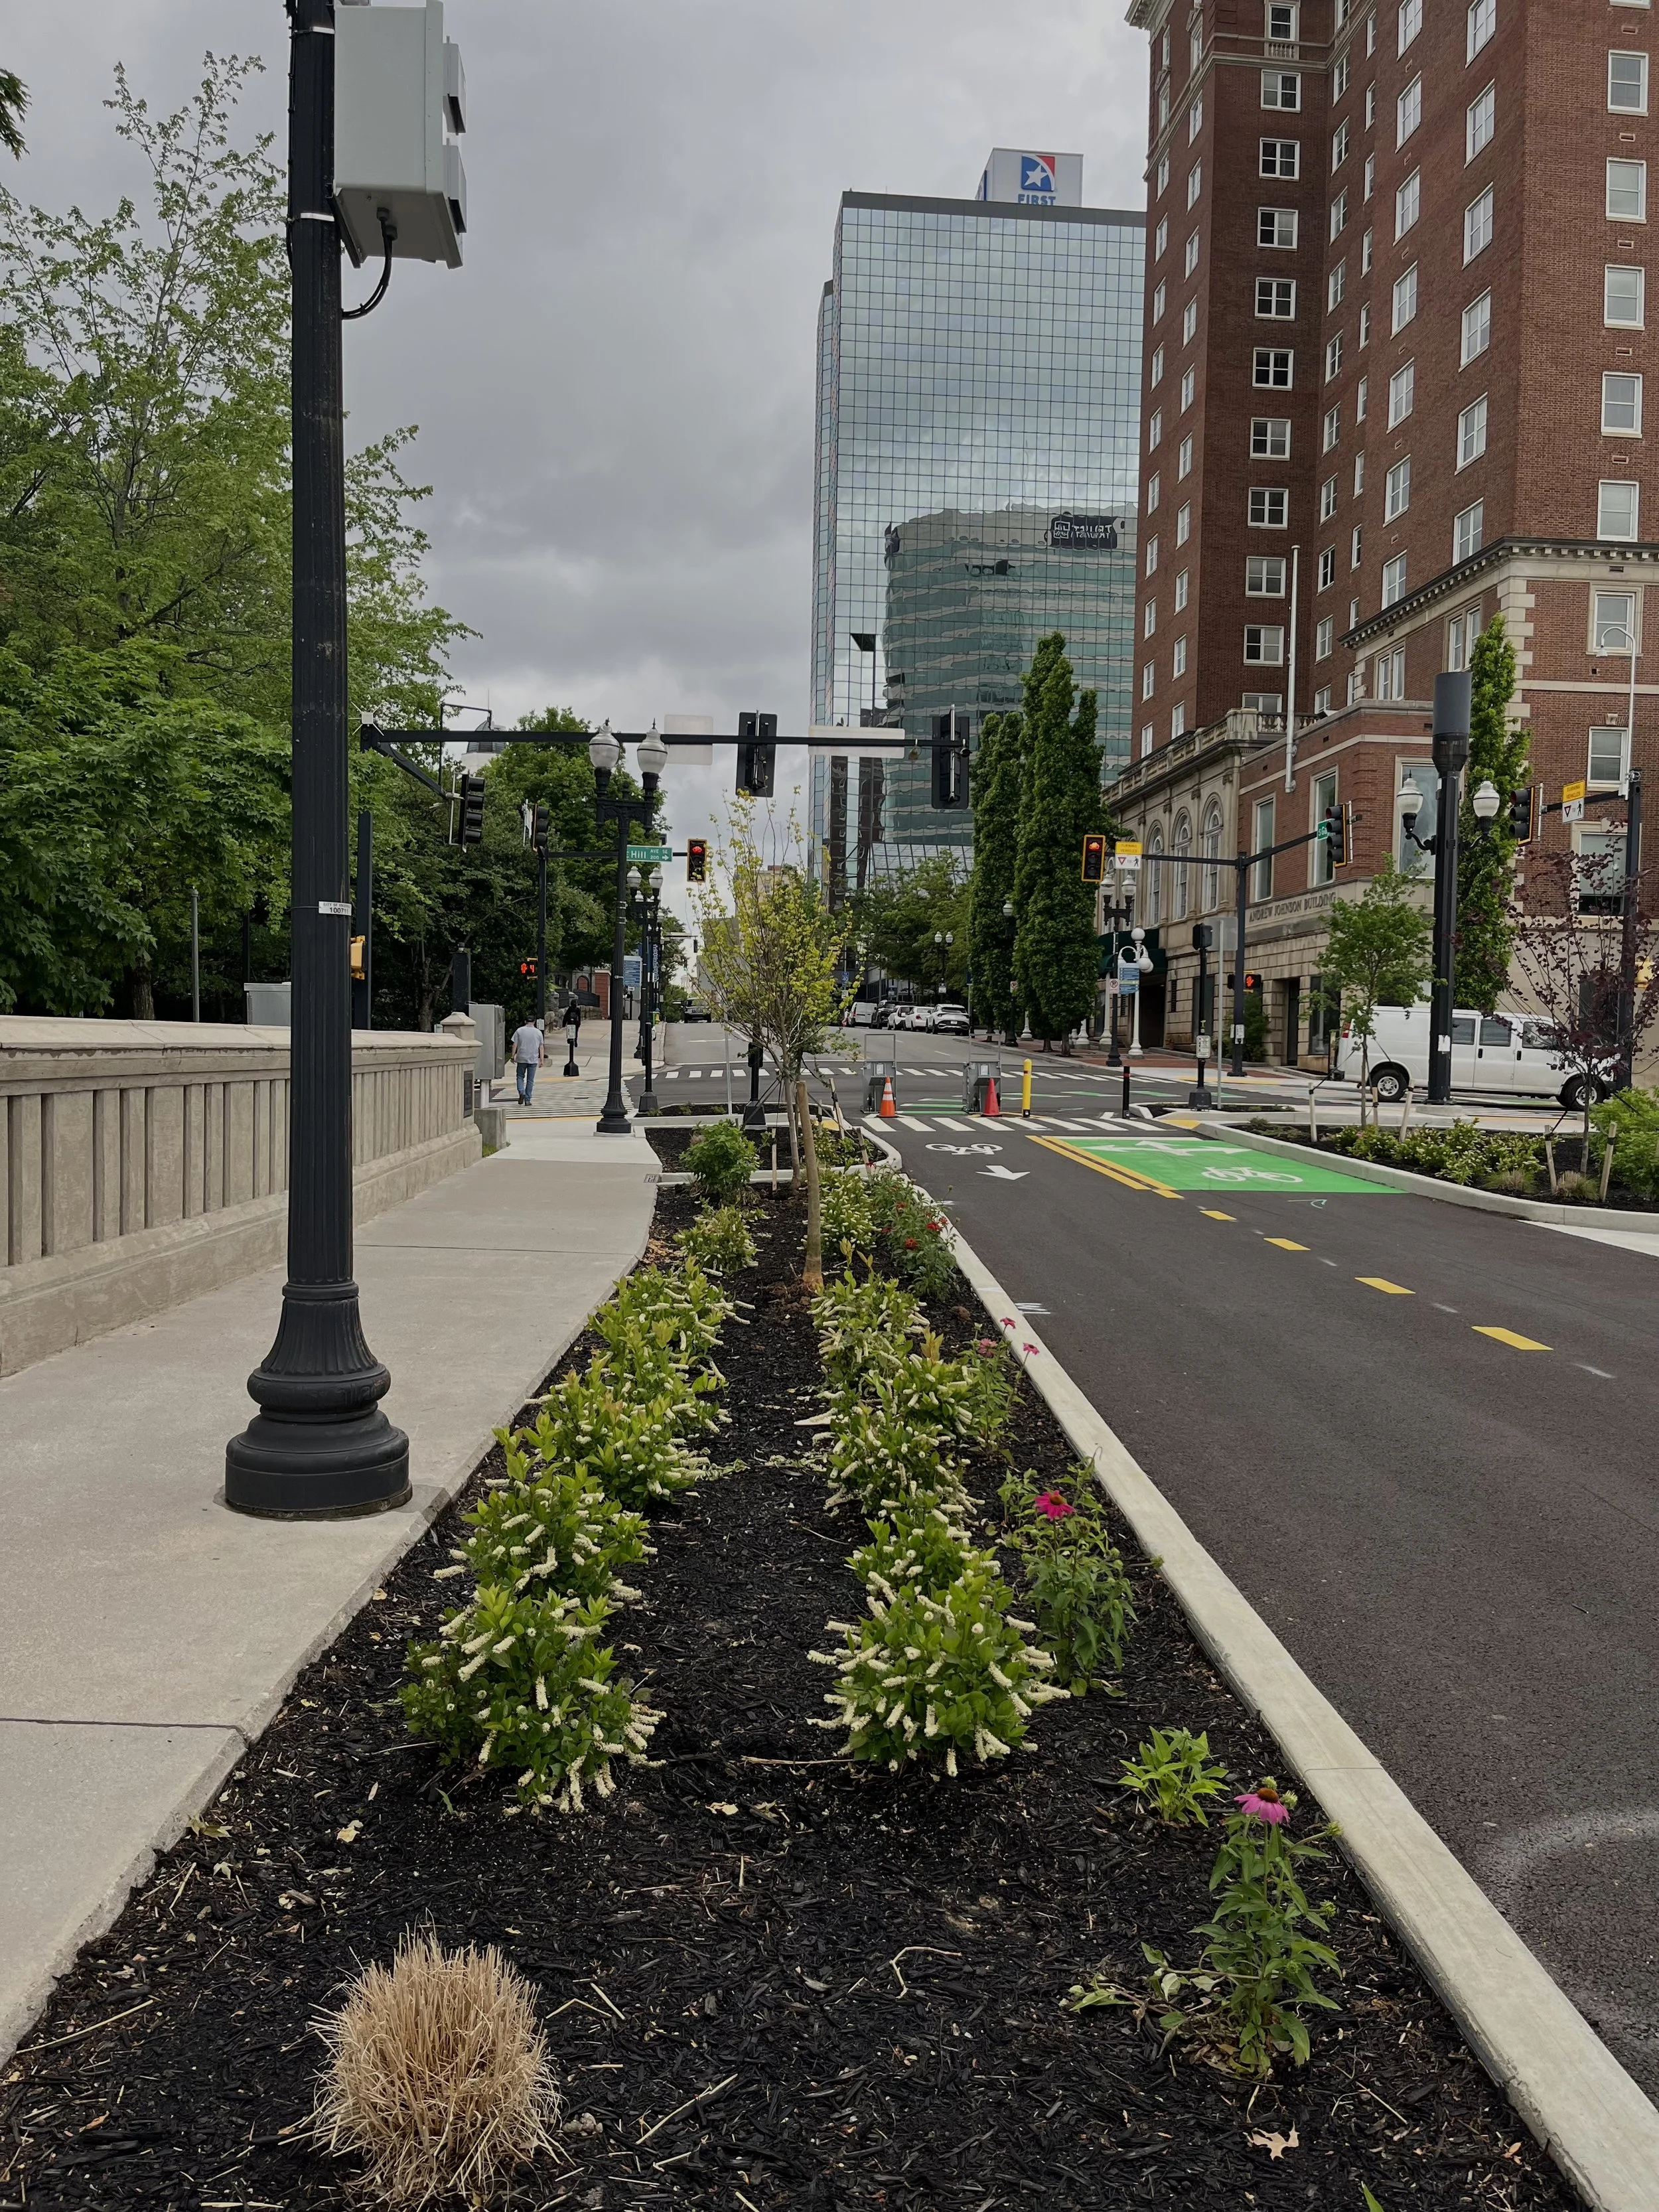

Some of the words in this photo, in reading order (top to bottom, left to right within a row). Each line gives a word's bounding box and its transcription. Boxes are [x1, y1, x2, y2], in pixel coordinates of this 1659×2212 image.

[1018, 194, 1056, 206] FIRST
[630, 850, 646, 859] Hill
[1249, 907, 1273, 922] ANDREW
[1274, 899, 1303, 916] JOHNSON
[1304, 892, 1336, 910] BUILDING
